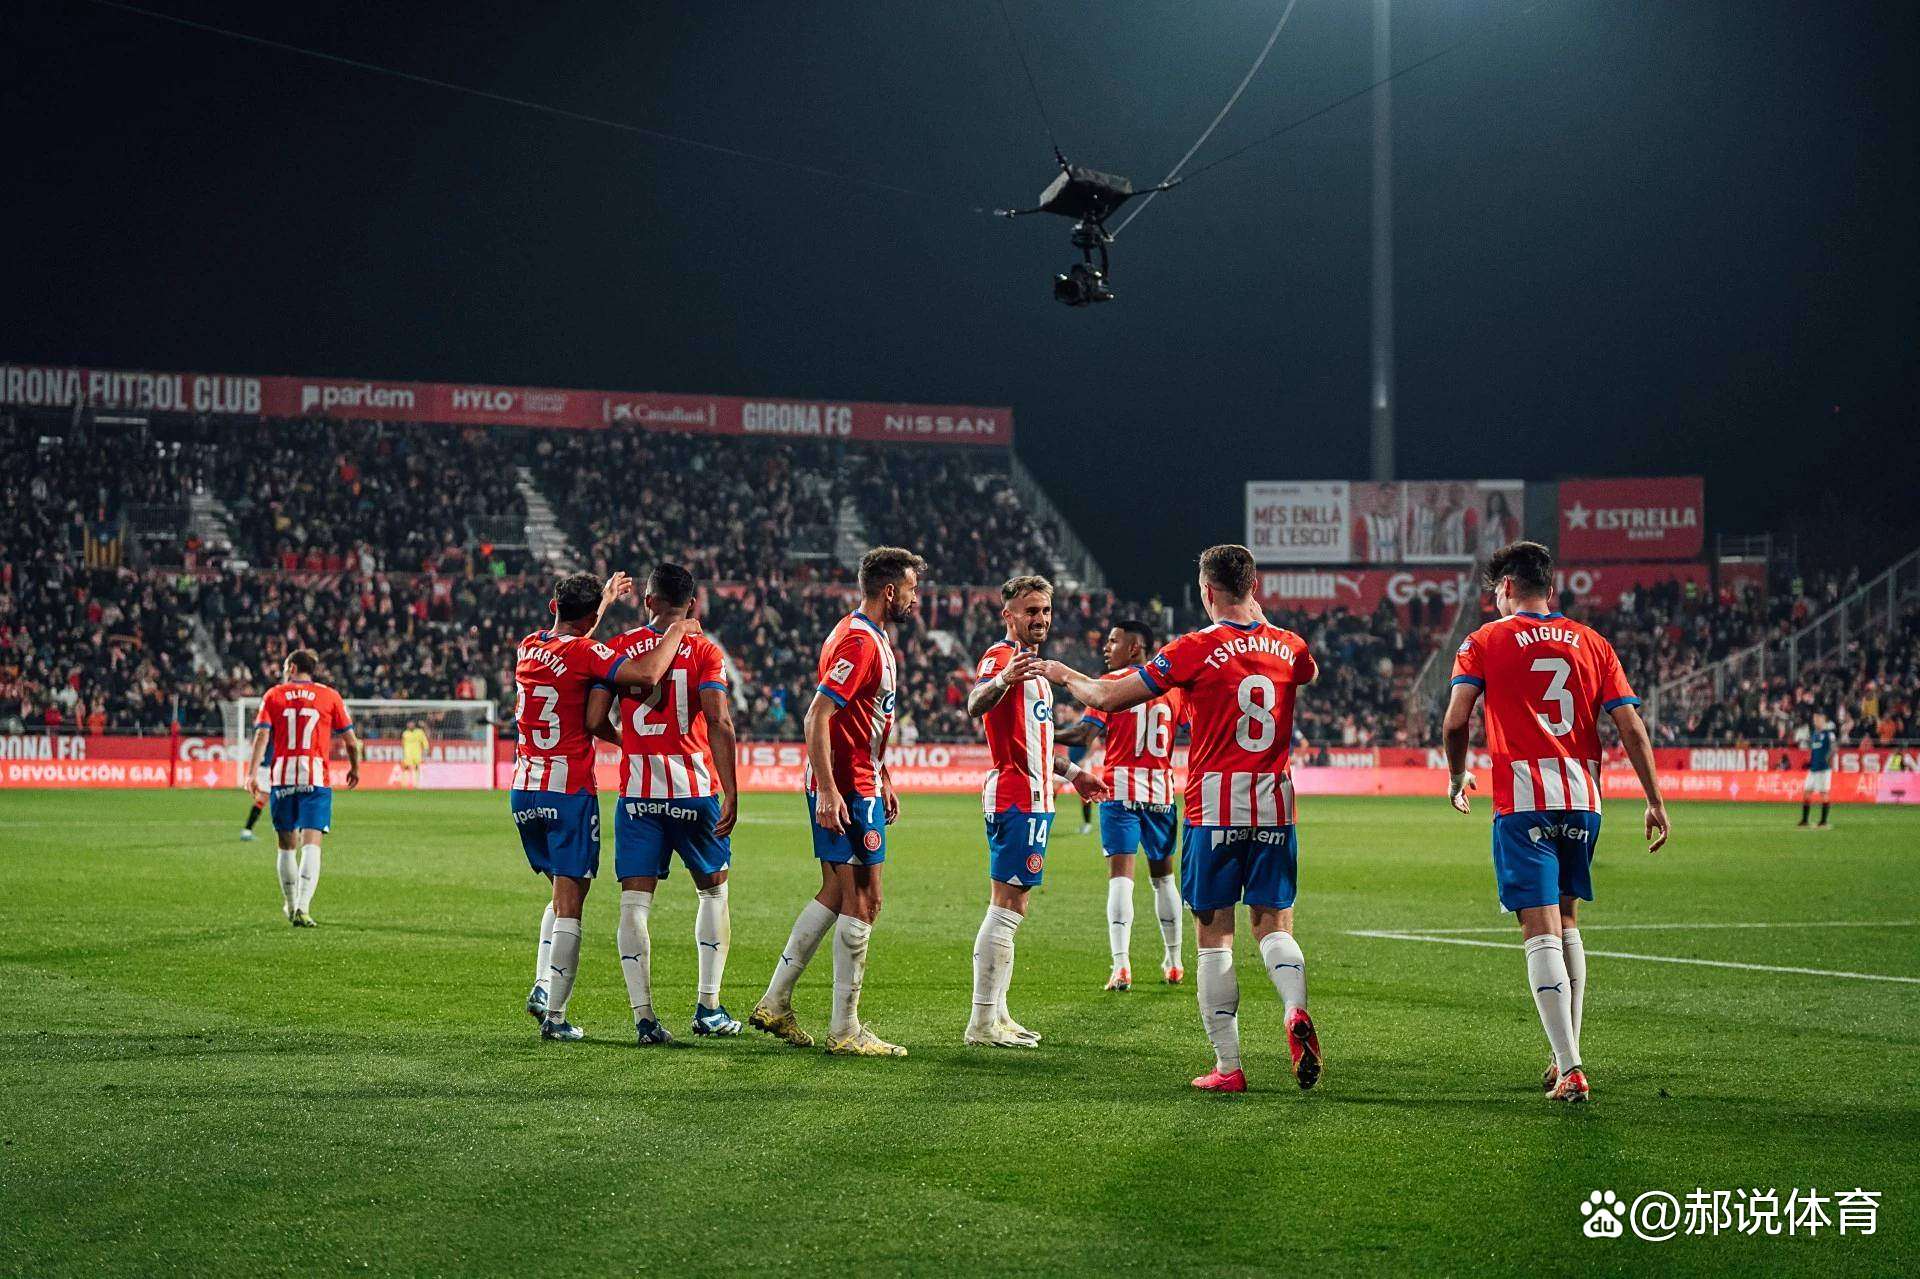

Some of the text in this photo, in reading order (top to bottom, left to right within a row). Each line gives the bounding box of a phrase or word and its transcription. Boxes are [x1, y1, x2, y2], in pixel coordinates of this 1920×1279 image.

[89, 369, 188, 411] FUTBOL
[194, 376, 262, 413] CLUB
[453, 389, 513, 411] HYLO
[742, 402, 853, 435] GIRONA FC
[885, 415, 996, 435] NISSAN
[1597, 507, 1698, 530] ESTRELLA
[1254, 527, 1271, 546] DE
[1515, 626, 1581, 648] MIGUEL
[1205, 636, 1297, 669] TSYGANKOV
[630, 669, 689, 736] 21
[1530, 657, 1575, 737] 3
[1235, 674, 1276, 753] 8
[283, 708, 320, 750] 17
[1130, 703, 1172, 757] 16
[57, 735, 86, 760] FC
[884, 746, 949, 768] HYLO
[9, 763, 125, 782] DEVOLUCIÓN
[129, 766, 193, 783] GRAIS
[637, 801, 698, 822] parlem
[865, 796, 877, 824] 7
[1027, 816, 1048, 848] 14
